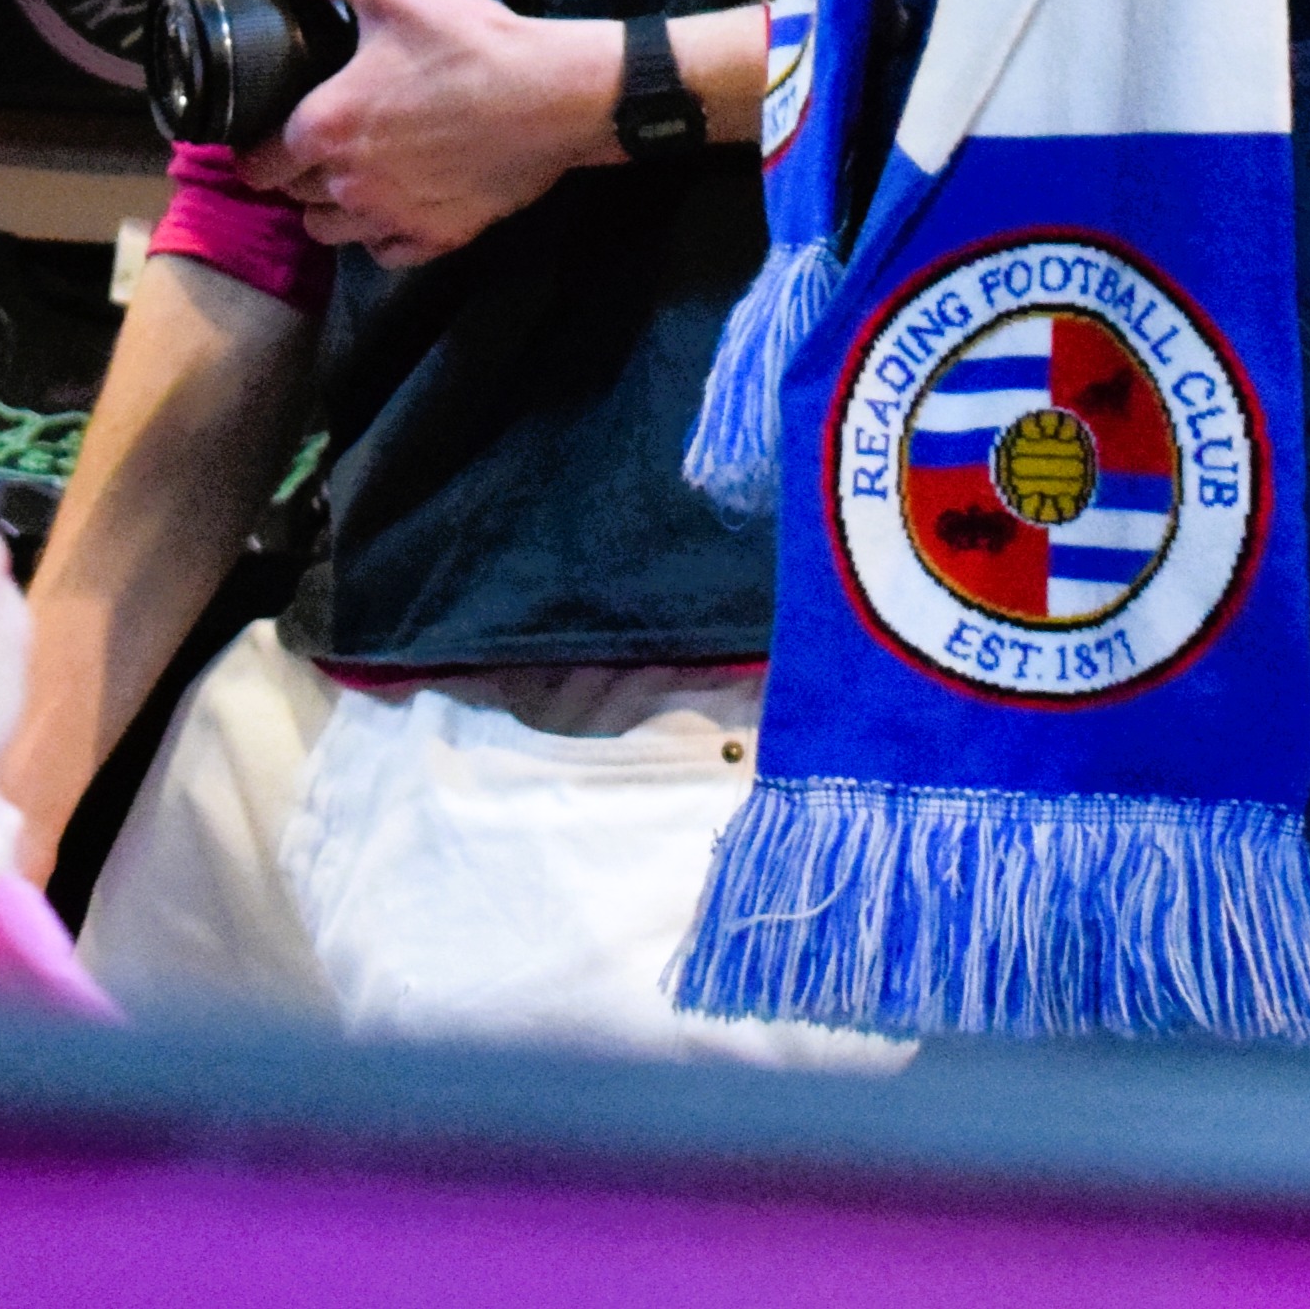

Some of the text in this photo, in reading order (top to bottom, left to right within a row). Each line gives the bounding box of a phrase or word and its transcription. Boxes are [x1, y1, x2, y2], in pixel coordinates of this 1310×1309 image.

[850, 254, 1240, 510] READING FOOTBALL CLUB
[944, 617, 1043, 682] EST.
